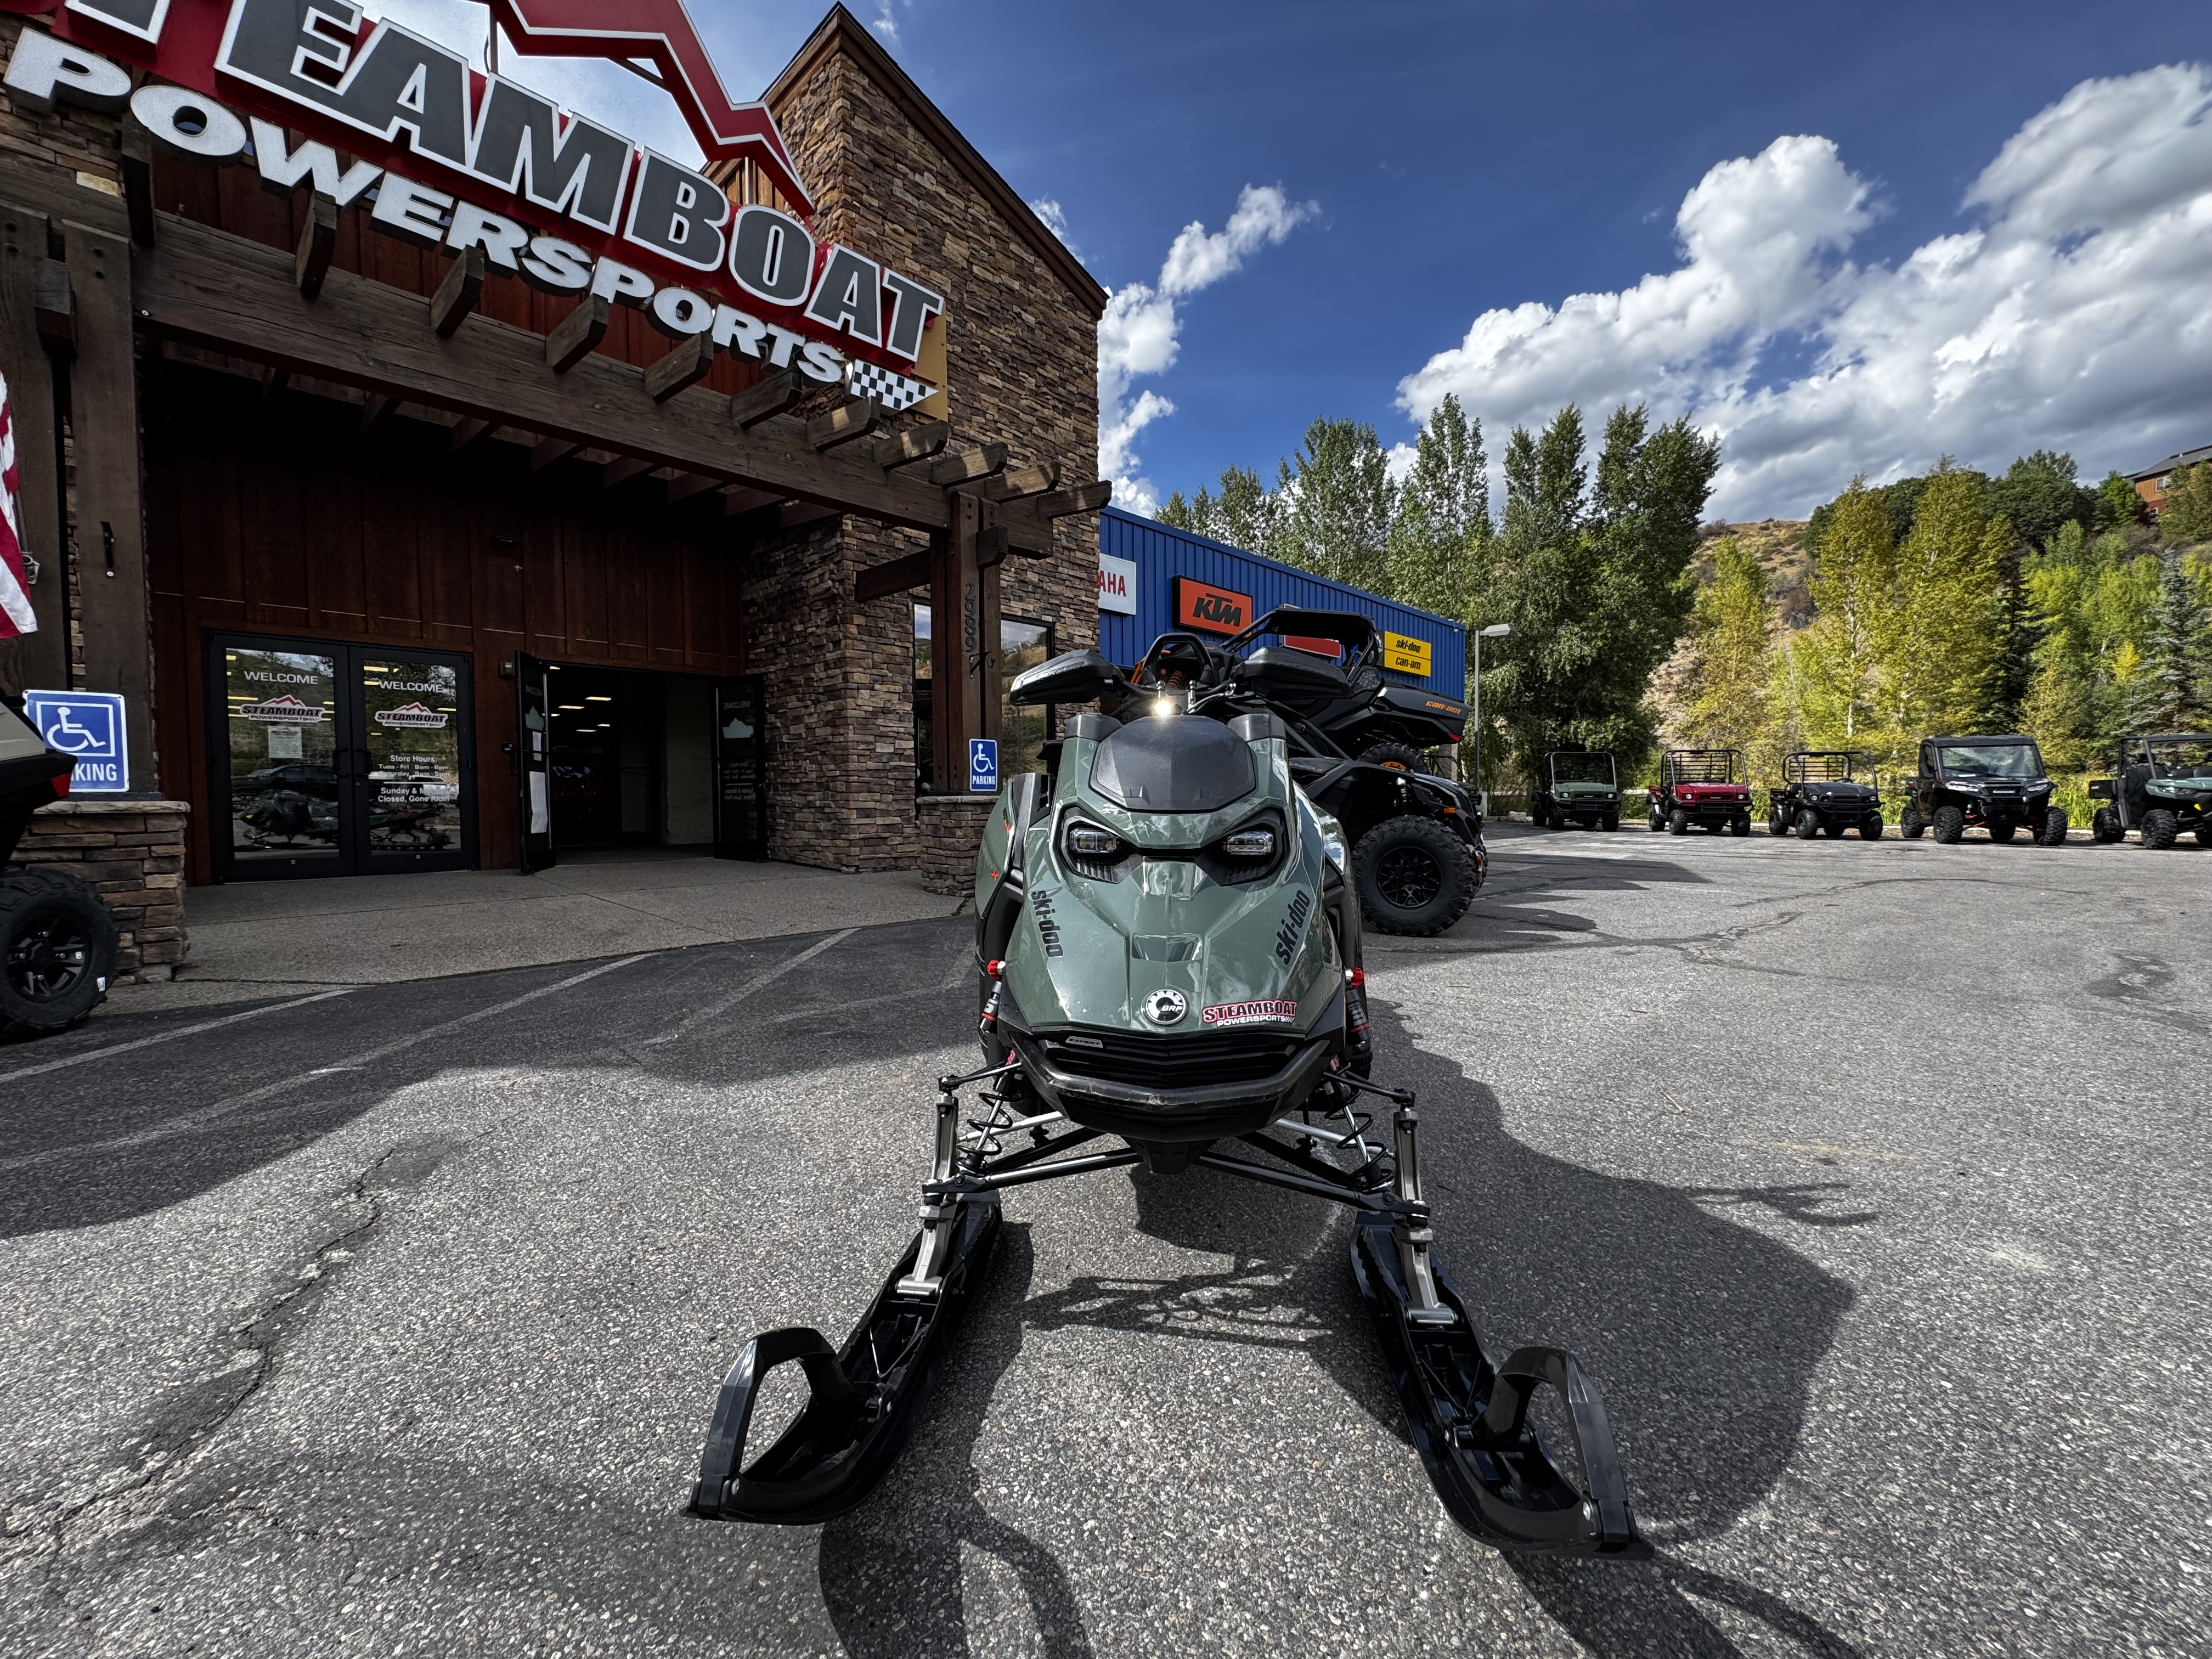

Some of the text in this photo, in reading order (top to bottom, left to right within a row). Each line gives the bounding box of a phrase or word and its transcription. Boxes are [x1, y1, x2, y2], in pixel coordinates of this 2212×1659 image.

[3, 26, 843, 383] POWERSPORTS
[1193, 593, 1242, 627] KTM
[964, 583, 976, 652] 2989
[1396, 639, 1421, 653] ski-doo
[1395, 657, 1421, 670] can-am
[244, 671, 319, 685] WELCOME
[379, 680, 444, 693] WELCOME
[242, 706, 323, 717] STEAMBOAT
[1425, 701, 1462, 714] can-am
[377, 713, 447, 723] STEAMBOAT
[972, 775, 996, 785] PARKING
[381, 787, 410, 795] Sunday
[1031, 890, 1063, 957] ski-doo
[1276, 889, 1310, 965] ski-doo
[1203, 1001, 1297, 1022] STEAMBOAT
[1217, 1016, 1286, 1027] POWERSPORTS
